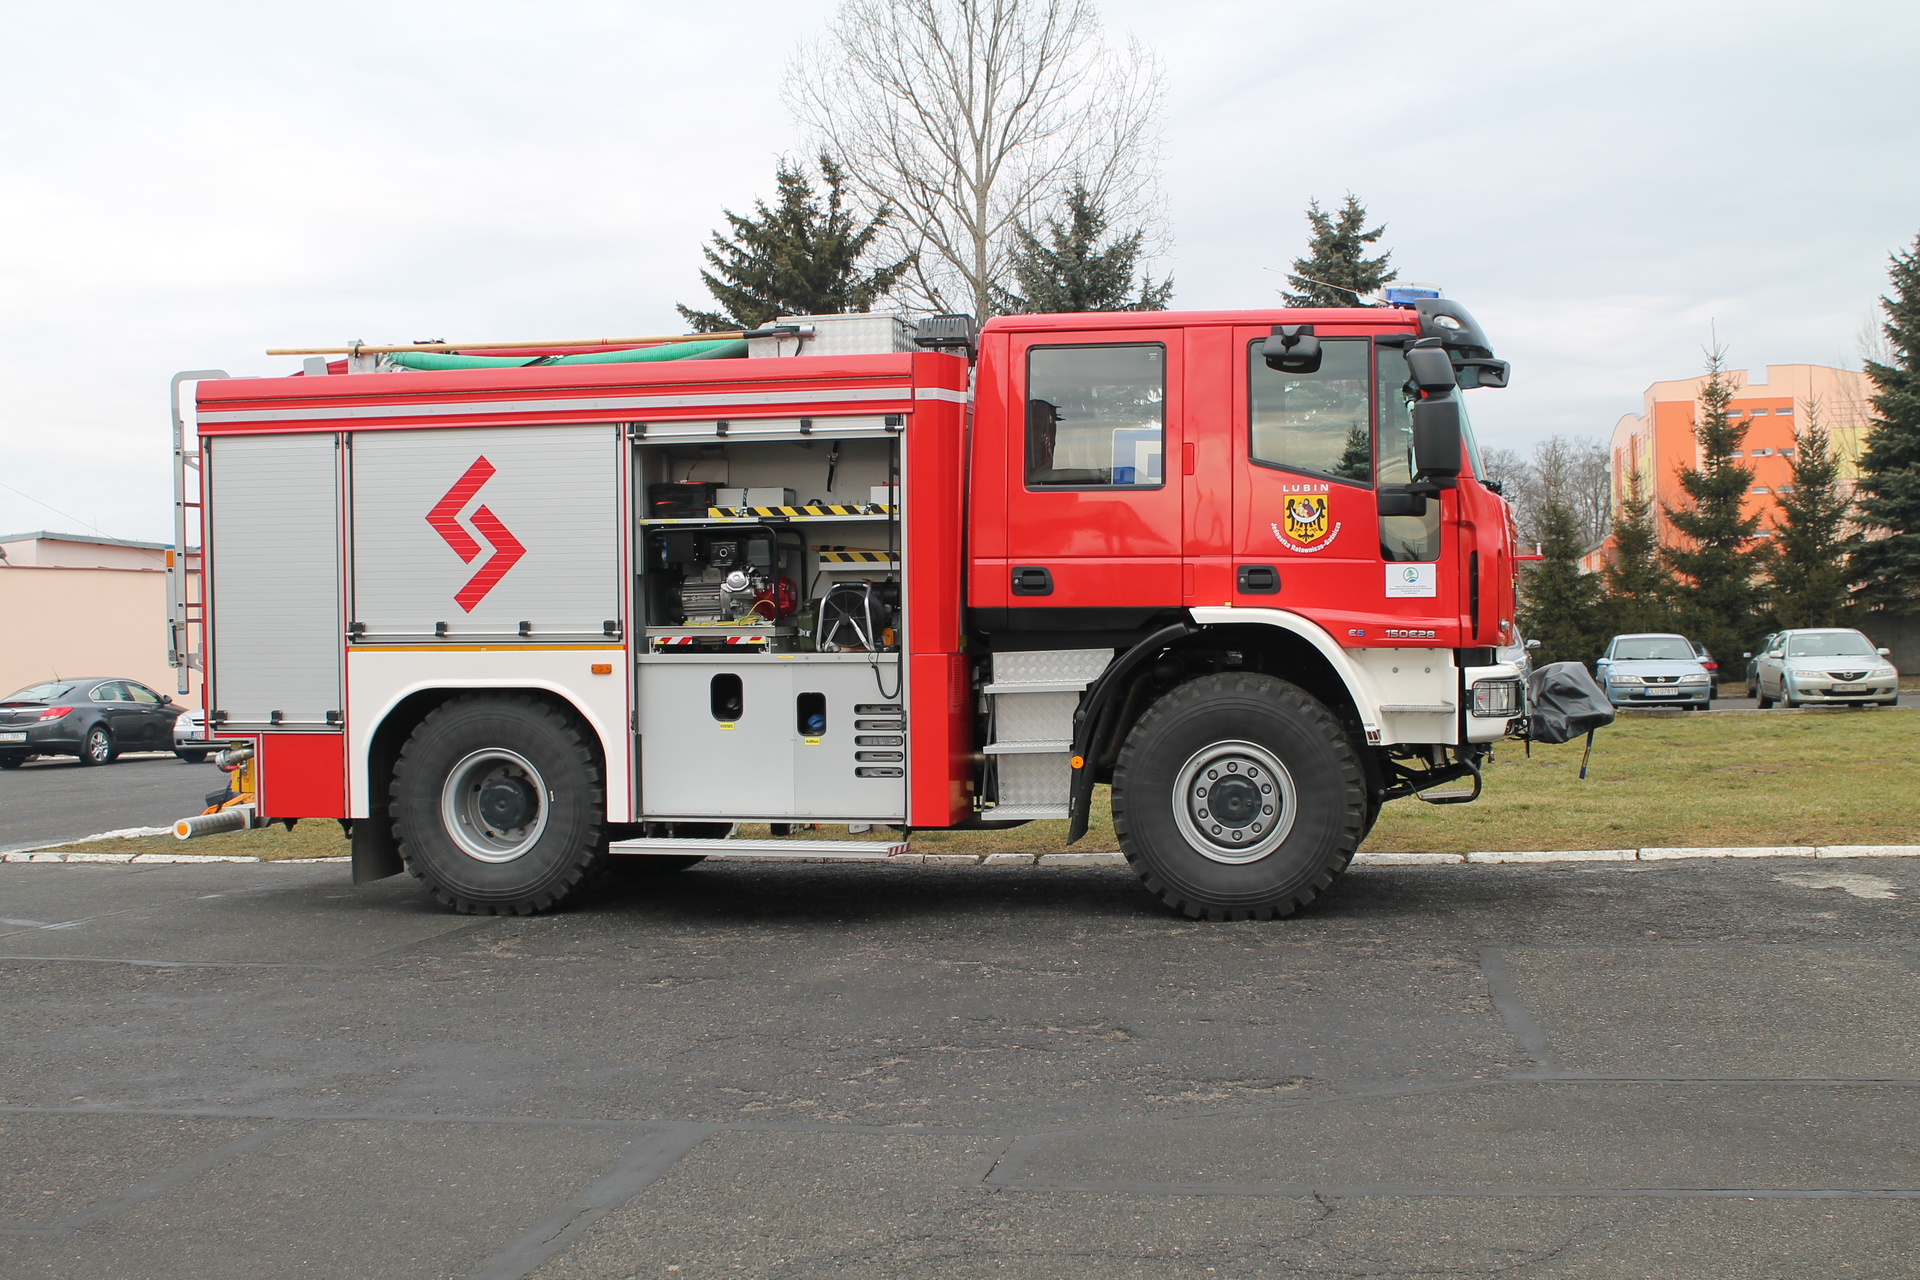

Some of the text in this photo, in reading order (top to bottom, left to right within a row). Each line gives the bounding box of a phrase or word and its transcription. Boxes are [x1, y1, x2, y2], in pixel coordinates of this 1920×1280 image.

[1282, 484, 1329, 492] LUBIN
[1270, 522, 1291, 549] Jednostka
[1348, 629, 1436, 638] E5 150E28
